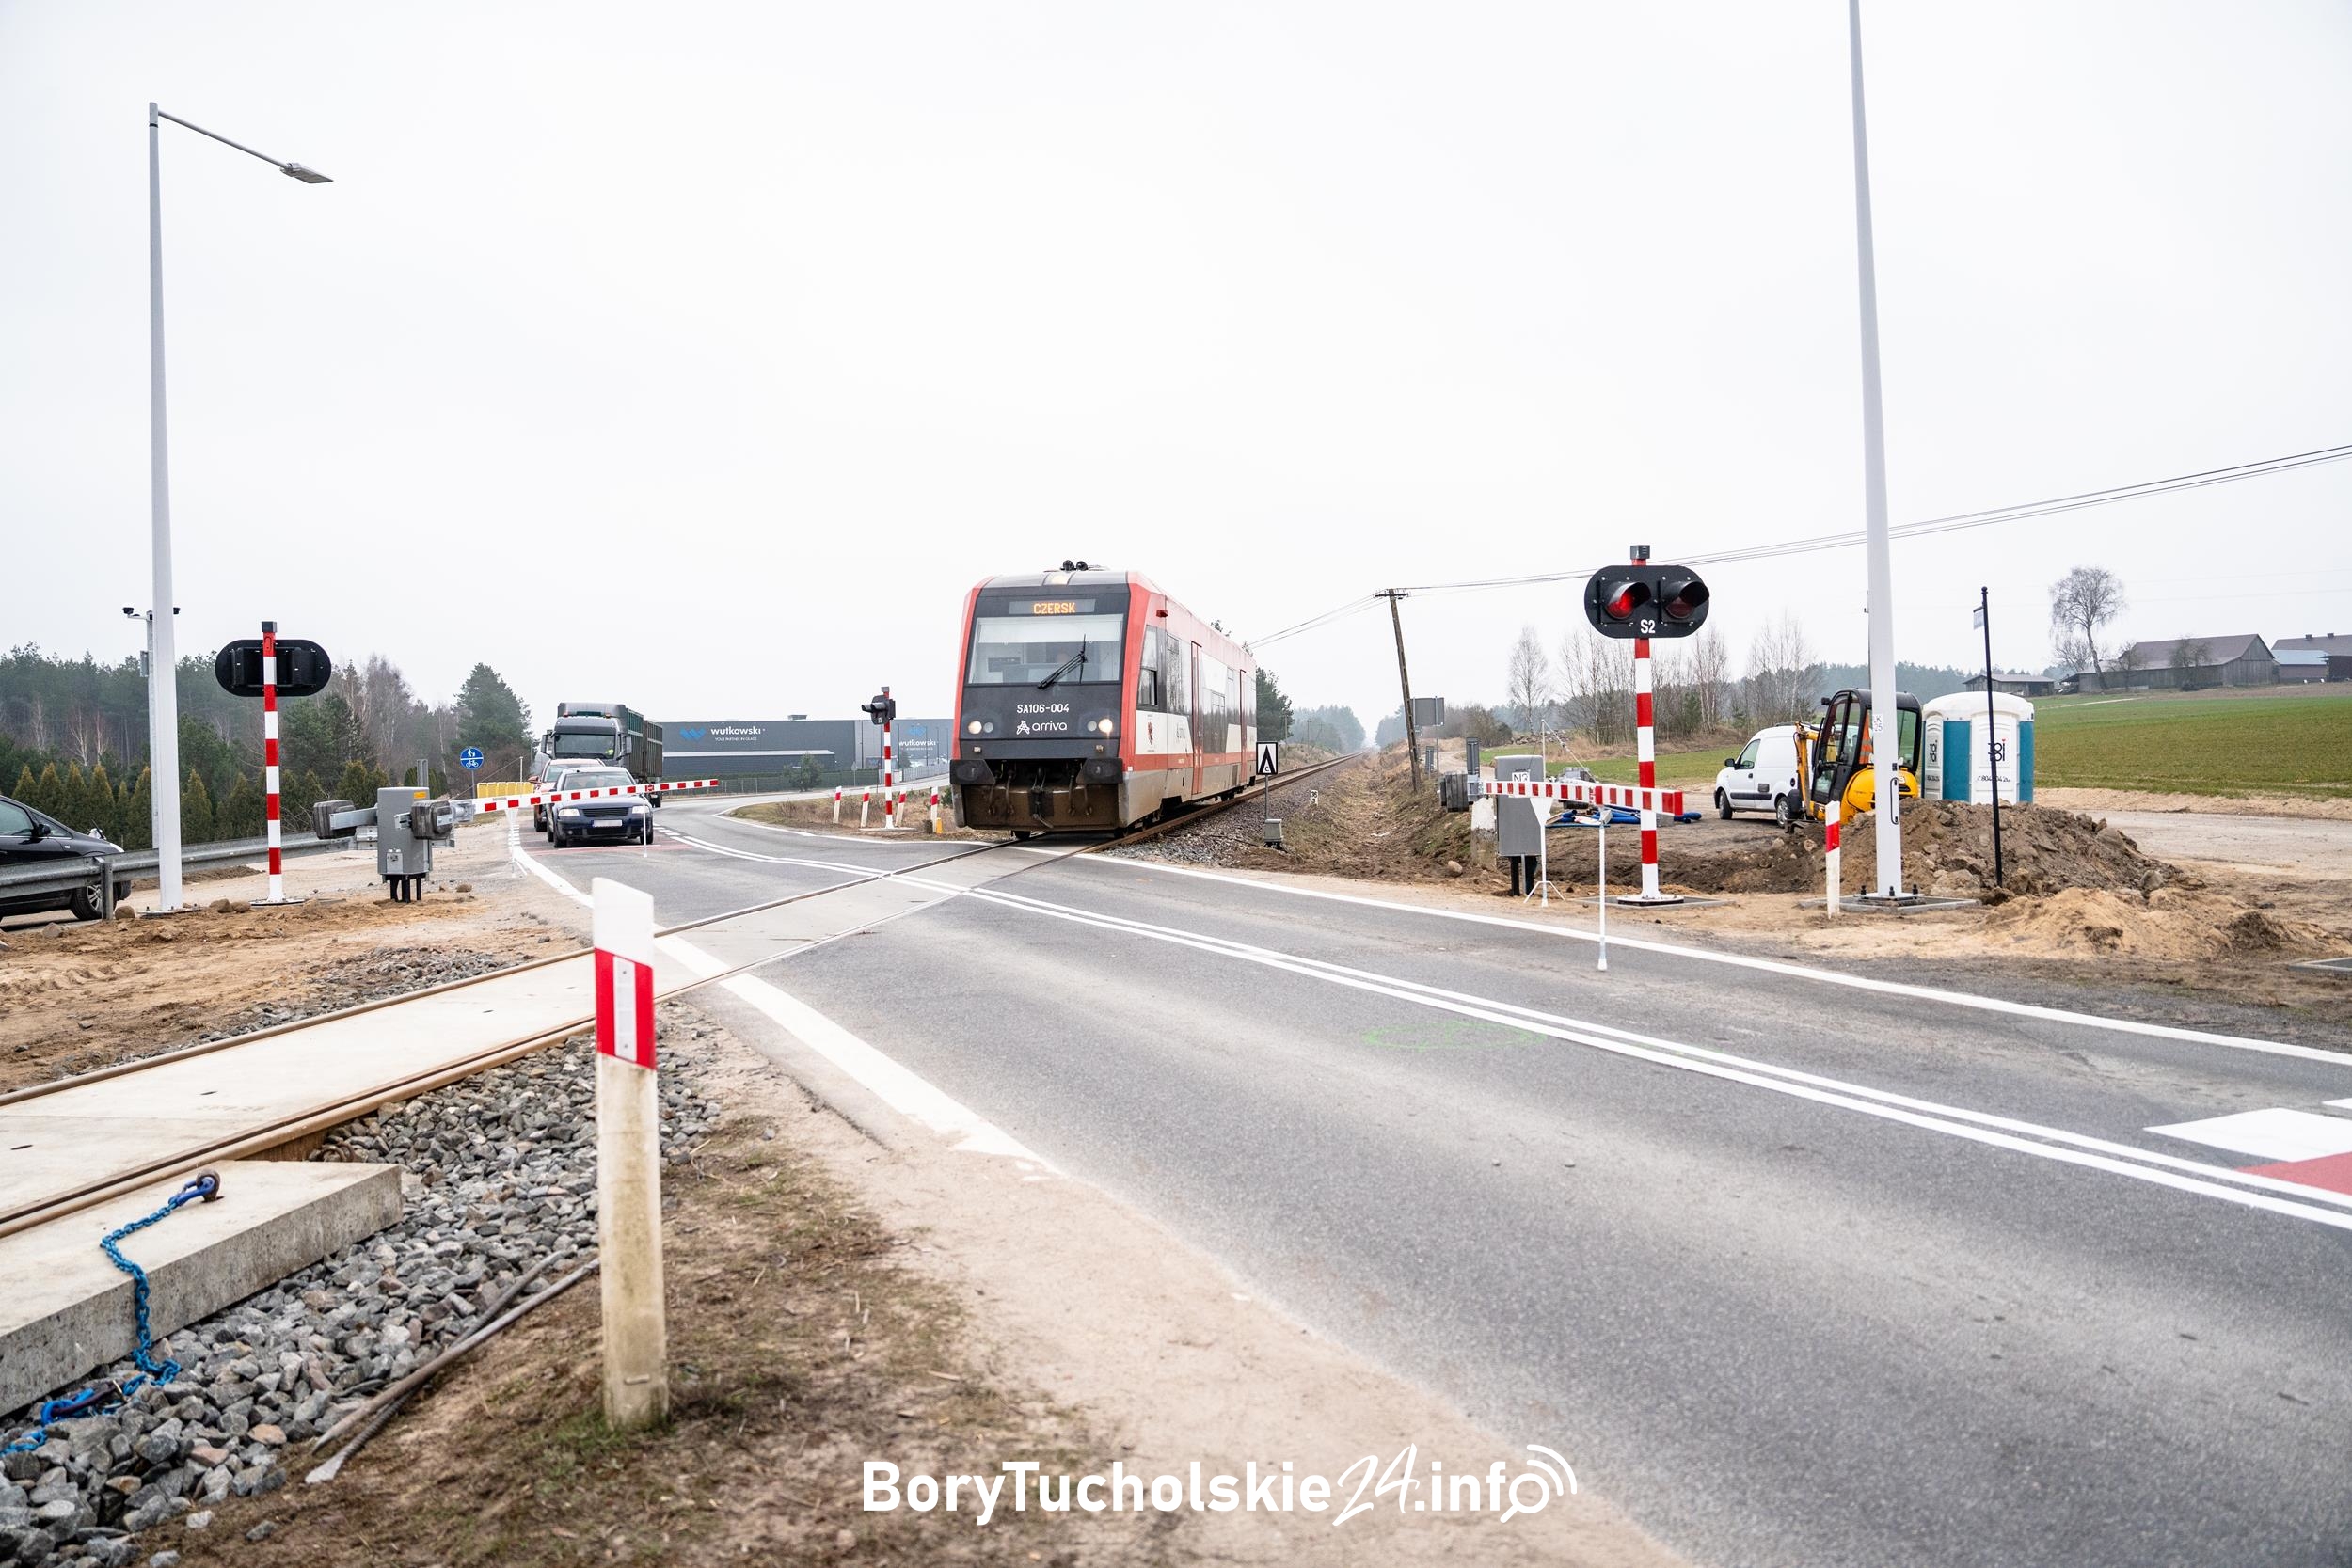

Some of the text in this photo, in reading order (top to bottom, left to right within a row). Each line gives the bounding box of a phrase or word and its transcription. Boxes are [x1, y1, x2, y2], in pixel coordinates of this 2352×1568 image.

[1033, 602, 1076, 614] CZERSK
[1640, 619, 1656, 634] S2
[1016, 703, 1070, 714] SA106-004
[710, 725, 761, 735] wutkowski
[1031, 720, 1068, 731] arriva
